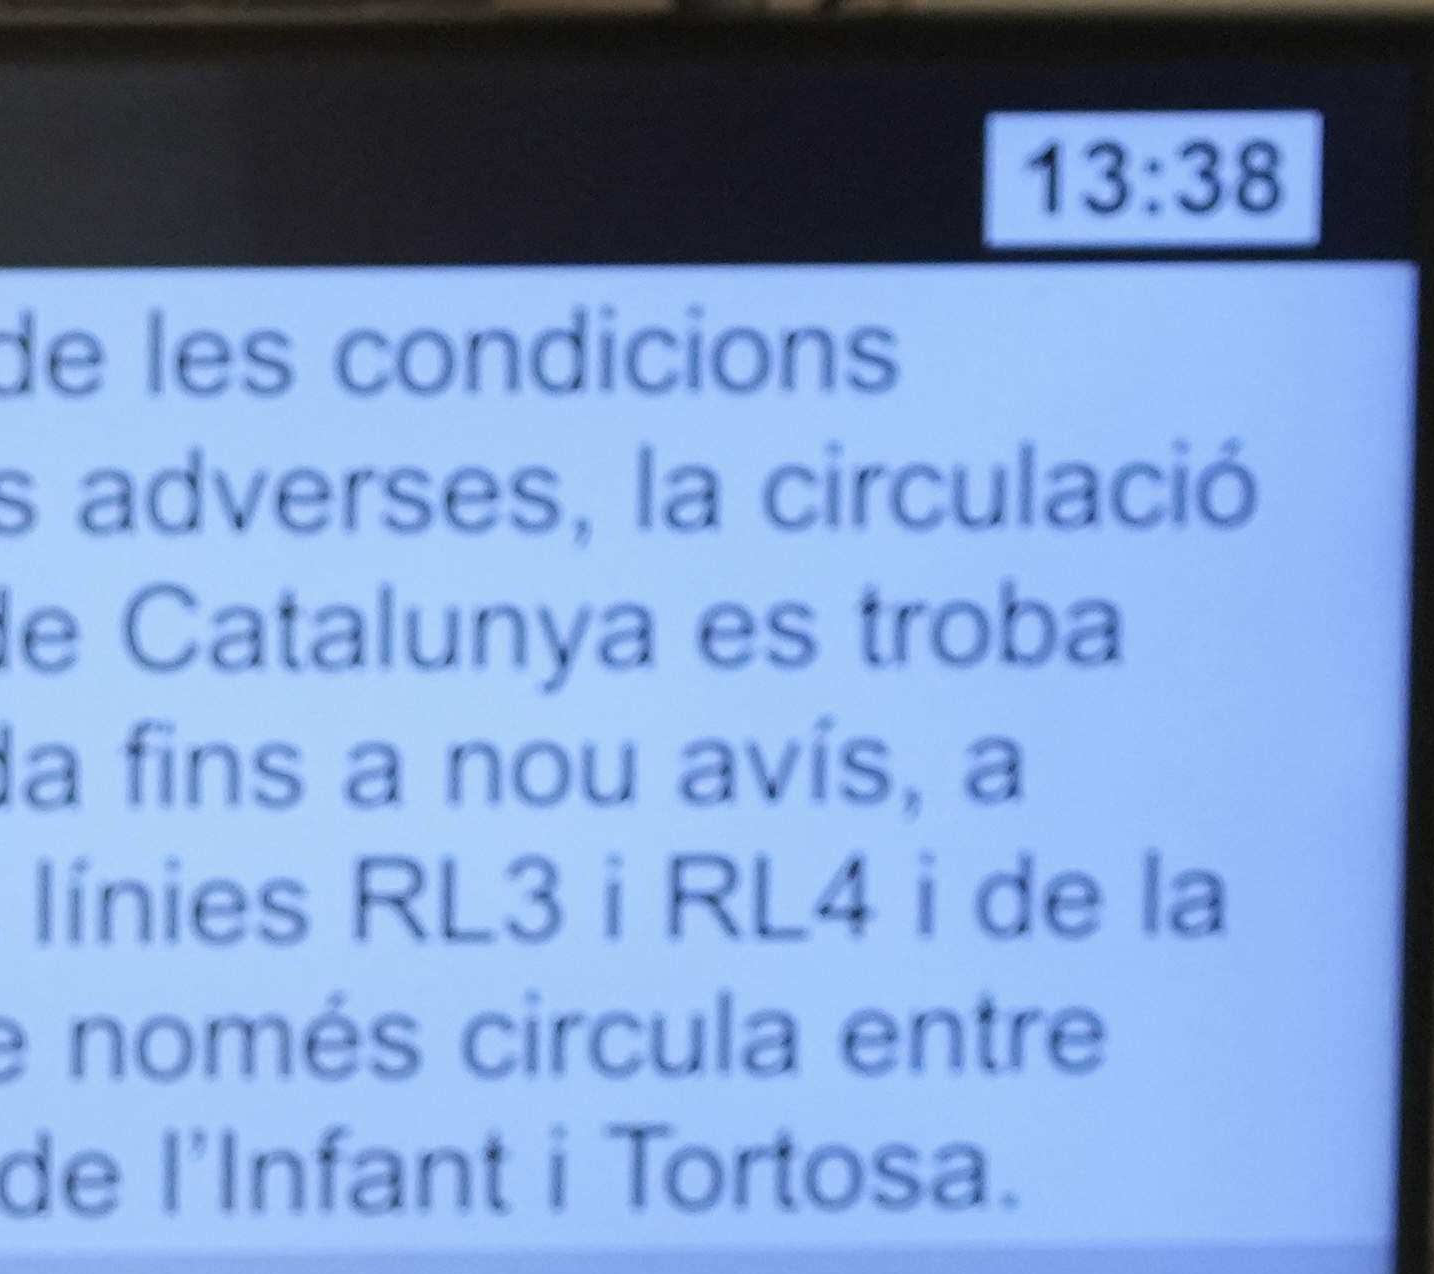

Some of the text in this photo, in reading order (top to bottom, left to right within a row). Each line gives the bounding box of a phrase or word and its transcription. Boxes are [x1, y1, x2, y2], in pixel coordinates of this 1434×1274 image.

[1027, 137, 1284, 217] 13:38
[145, 308, 298, 400] les
[331, 304, 902, 400] condicions
[74, 445, 593, 547] adverses,
[635, 442, 723, 536] la
[759, 436, 1260, 535] circulació
[119, 579, 657, 697] Catalunya
[693, 599, 820, 673] es
[856, 578, 1124, 671] troba
[121, 717, 306, 813] fins
[341, 739, 404, 812] a
[444, 738, 639, 811] nou
[675, 714, 923, 818] avís,
[962, 734, 1025, 807] a
[34, 856, 312, 949] línies
[351, 852, 566, 947] RL3
[603, 853, 624, 943] i
[664, 850, 877, 944] RL4
[915, 851, 937, 939] i
[972, 849, 1105, 942] de
[1141, 848, 1228, 941] la
[68, 991, 425, 1085] només
[458, 988, 801, 1082] circula
[837, 991, 1108, 1079] entre
[160, 1123, 511, 1218] l’Infant
[547, 1123, 568, 1214] i
[604, 1121, 1019, 1215] Tortosa.
